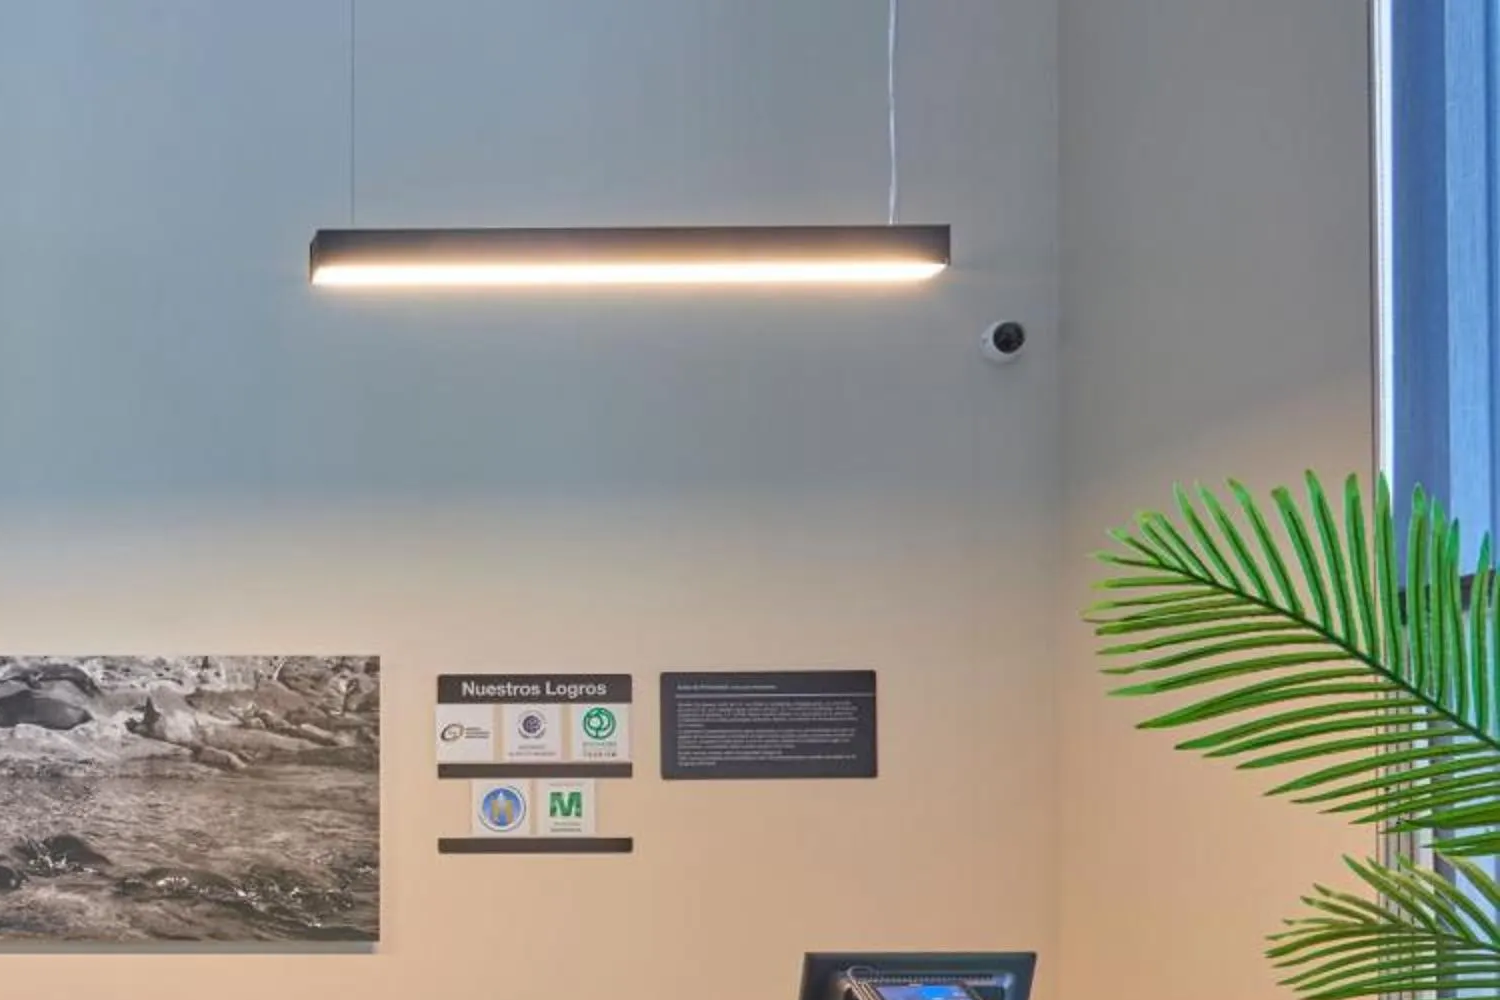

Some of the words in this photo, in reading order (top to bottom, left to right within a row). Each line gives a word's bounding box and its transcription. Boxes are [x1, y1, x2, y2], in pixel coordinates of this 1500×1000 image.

[461, 681, 541, 698] Nuestros
[545, 681, 607, 699] Logros
[549, 791, 582, 818] M
